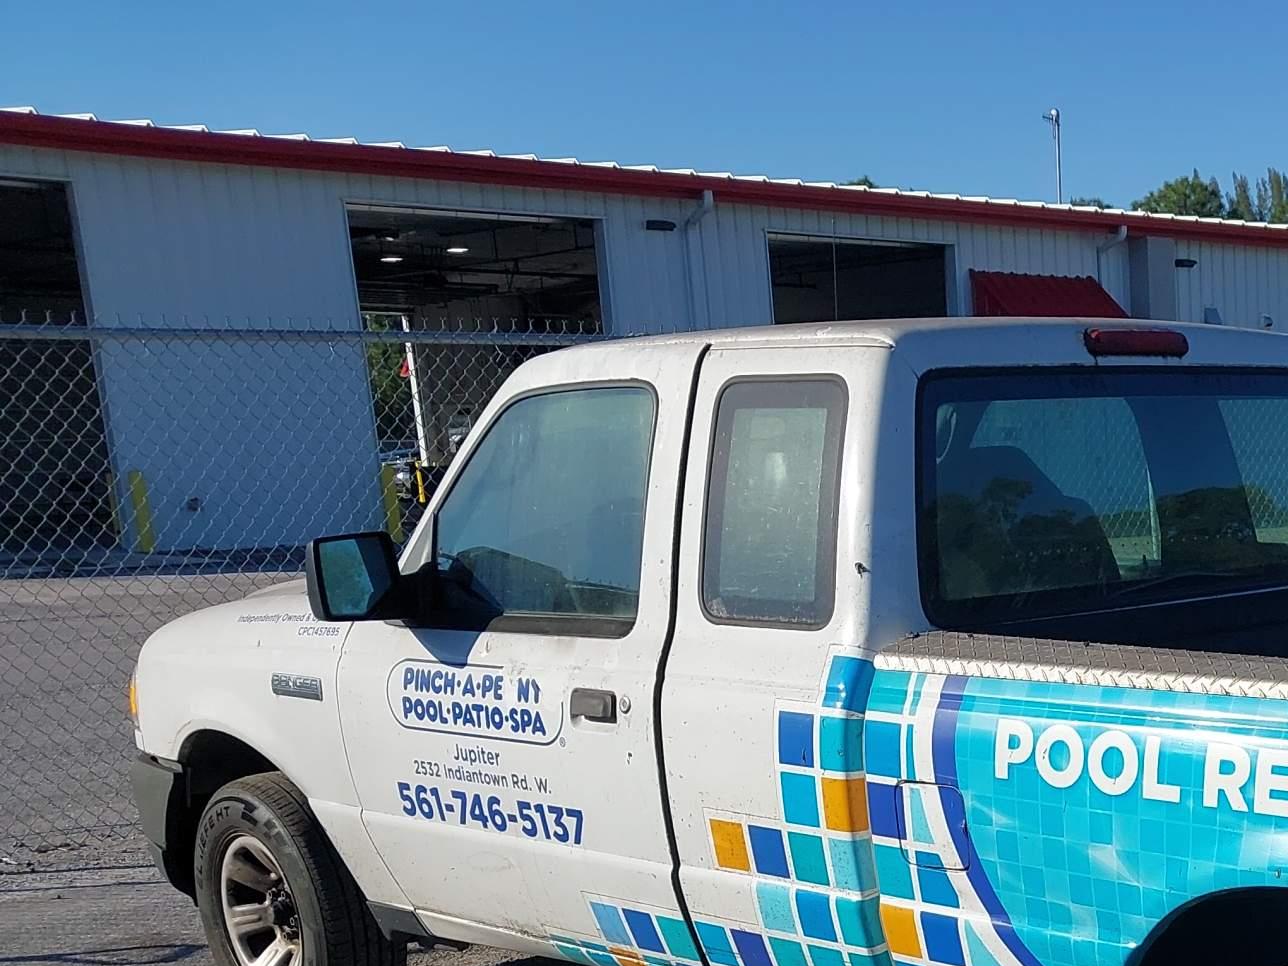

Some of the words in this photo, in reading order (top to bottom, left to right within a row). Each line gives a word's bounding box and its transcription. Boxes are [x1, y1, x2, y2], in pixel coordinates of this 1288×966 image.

[281, 612, 306, 624] Owned
[453, 743, 501, 767] Jupiter
[993, 718, 1182, 804] POOL
[413, 759, 442, 778] 2532
[443, 763, 509, 788] Indiantown
[511, 773, 533, 792] Rd.
[534, 776, 553, 795] W.
[397, 781, 584, 846] 561-746-5137
